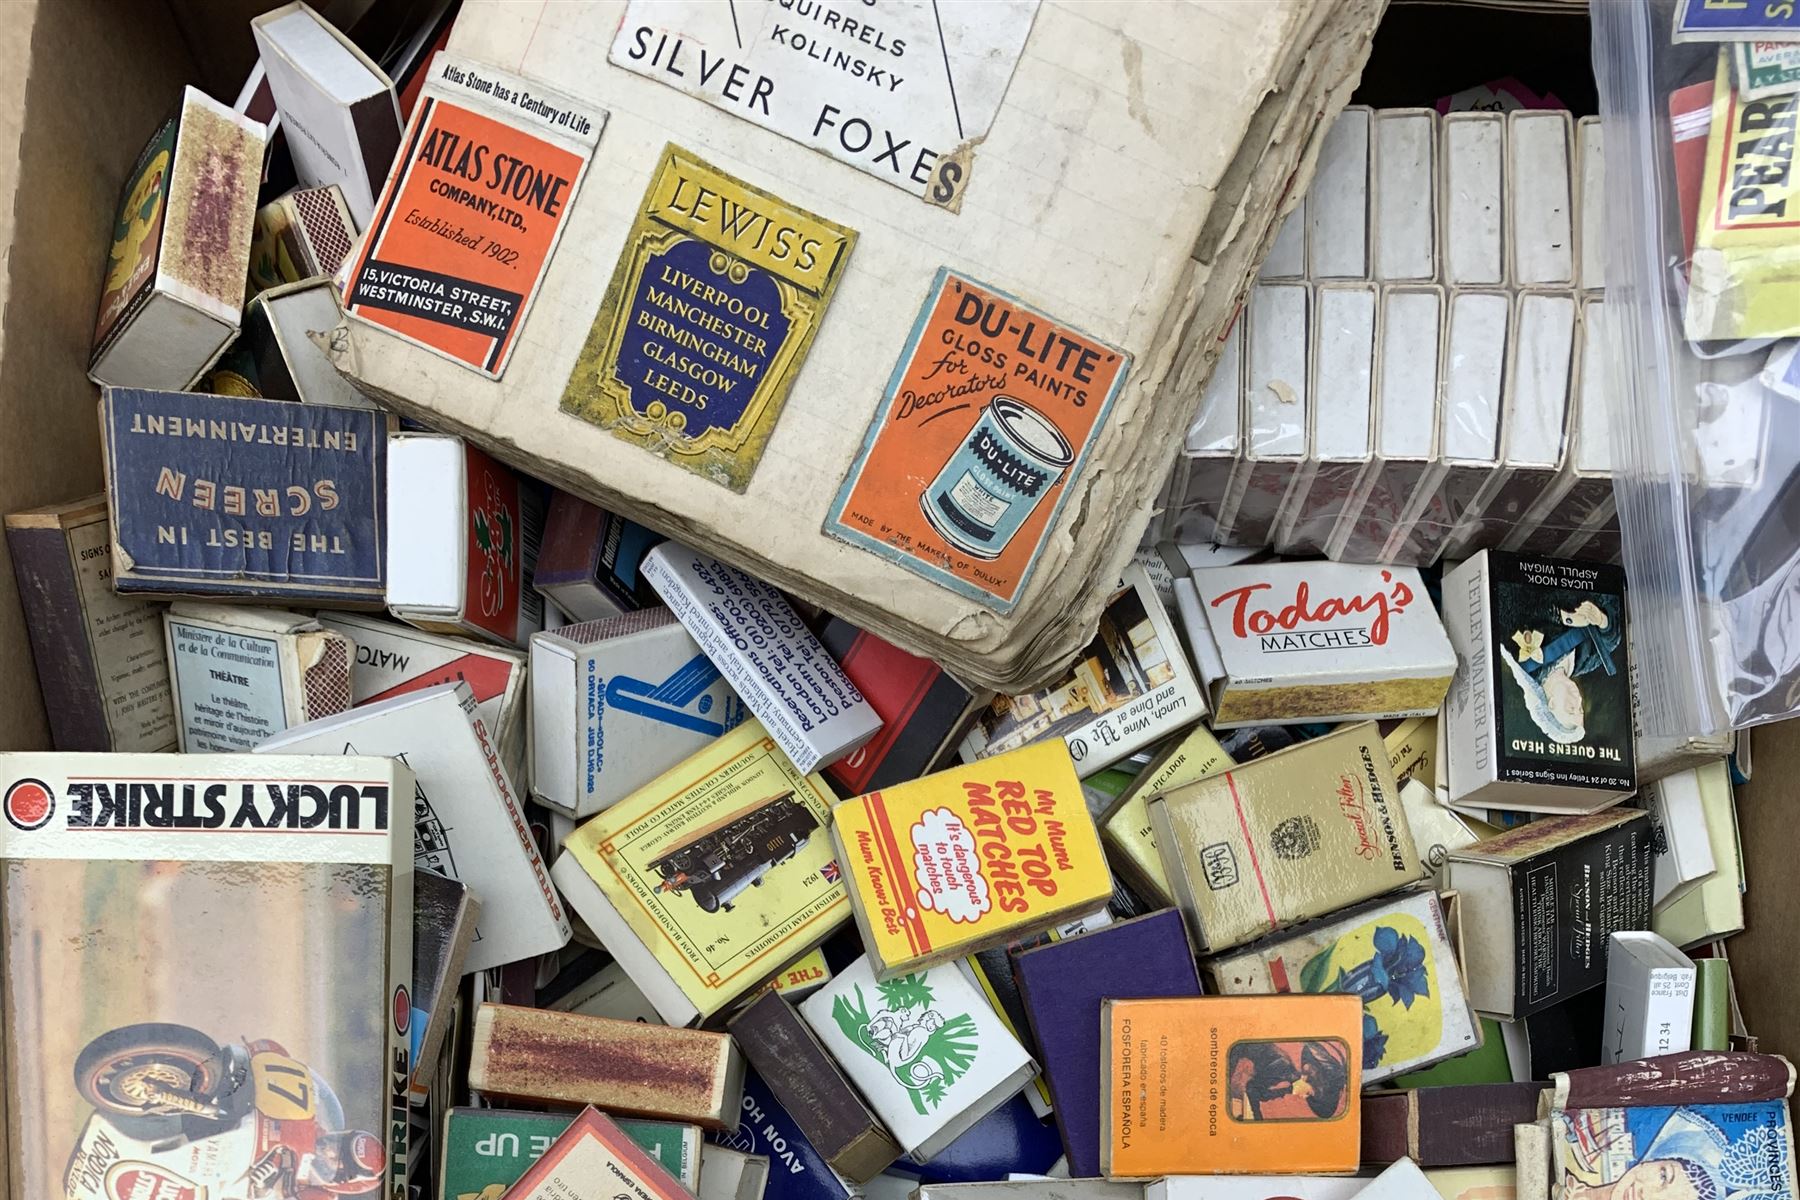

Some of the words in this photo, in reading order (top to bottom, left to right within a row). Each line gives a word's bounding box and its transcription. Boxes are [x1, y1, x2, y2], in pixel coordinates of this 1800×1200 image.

[771, 24, 904, 92] KOLINSKY
[442, 64, 465, 88] Atlas
[466, 68, 492, 93] Stone
[493, 82, 510, 101] has
[511, 92, 518, 104] a
[520, 95, 558, 124] Century
[558, 107, 570, 126] of
[568, 113, 592, 135] Life
[628, 26, 774, 116] SILVER
[812, 104, 962, 201] FOXES
[419, 128, 489, 181] ATLAS
[486, 154, 568, 218] STONE
[405, 209, 480, 251] Established
[482, 241, 519, 269] 1902.
[668, 177, 822, 272] LEWIS'S
[661, 265, 770, 330] LIVERPOOL
[637, 310, 759, 378] BIRMINGHAM
[646, 286, 767, 357] MANCHESTER
[643, 341, 737, 393] GLASGOW
[922, 351, 969, 380] for
[942, 329, 1005, 369] GLOSS
[1014, 363, 1088, 407] PAINTS
[644, 368, 708, 410] LEEDS
[896, 372, 1006, 420] Decorators
[130, 413, 357, 452] ENTERTAINMENT
[980, 435, 1037, 487] DU-LITE
[156, 466, 340, 517] SCREEN
[158, 526, 187, 545] IN
[206, 528, 272, 550] BEST
[293, 532, 344, 554] THE
[851, 512, 875, 527] MADE
[880, 523, 892, 533] BY
[896, 531, 911, 544] THE
[917, 542, 953, 563] MAKERS
[956, 561, 970, 571] OF
[1519, 561, 1555, 575] WIGAN
[1561, 578, 1594, 590] LUCAS
[708, 601, 749, 651] Offices:
[1212, 570, 1414, 645] Today's
[1468, 570, 1482, 643] TETLEY
[216, 635, 225, 645] de
[229, 636, 236, 647] la
[240, 638, 272, 654] Culture
[1260, 628, 1373, 651] MATCHES
[749, 650, 815, 733] Reservations
[1129, 699, 1154, 719] Dine
[1150, 697, 1187, 725] Lunch,
[1155, 687, 1175, 705] and
[1471, 652, 1486, 730] WALKER
[1117, 708, 1128, 724] at
[1124, 716, 1150, 736] Wine
[1475, 734, 1488, 770] LTD
[1512, 739, 1544, 754] HEAD
[1549, 743, 1595, 759] QUEENS
[1599, 748, 1622, 761] THE
[1511, 769, 1534, 778] Series
[1536, 771, 1555, 780] Signs
[1569, 773, 1589, 783] Tetley
[66, 783, 226, 828] STRIKE
[230, 785, 389, 830] LUCKY
[472, 719, 532, 854] Schooner
[531, 855, 560, 922] Inns
[1034, 790, 1056, 816] My
[935, 842, 948, 855] to
[962, 782, 1029, 914] MATCHES
[995, 781, 1037, 836] RED
[1017, 843, 1057, 896] TOP
[1044, 821, 1073, 871] Mums
[856, 830, 873, 864] Mum
[867, 866, 890, 906] Knows
[882, 908, 900, 936] Best
[918, 844, 943, 894] matches
[939, 858, 959, 891] touch
[945, 823, 960, 842] It's
[953, 843, 982, 906] dangerous
[792, 912, 814, 927] STEAM
[813, 891, 841, 913] BRITISH
[745, 924, 793, 959] LOCOMOTIVES
[1121, 1018, 1132, 1088] FOSFORERA
[265, 1064, 309, 1112] 17
[1121, 1089, 1132, 1149] ESPAÑOLA
[1722, 1112, 1758, 1124] VENDEE
[475, 1132, 519, 1158] UP
[762, 1121, 805, 1176] AVON
[1766, 1111, 1782, 1192] PROVINCES
